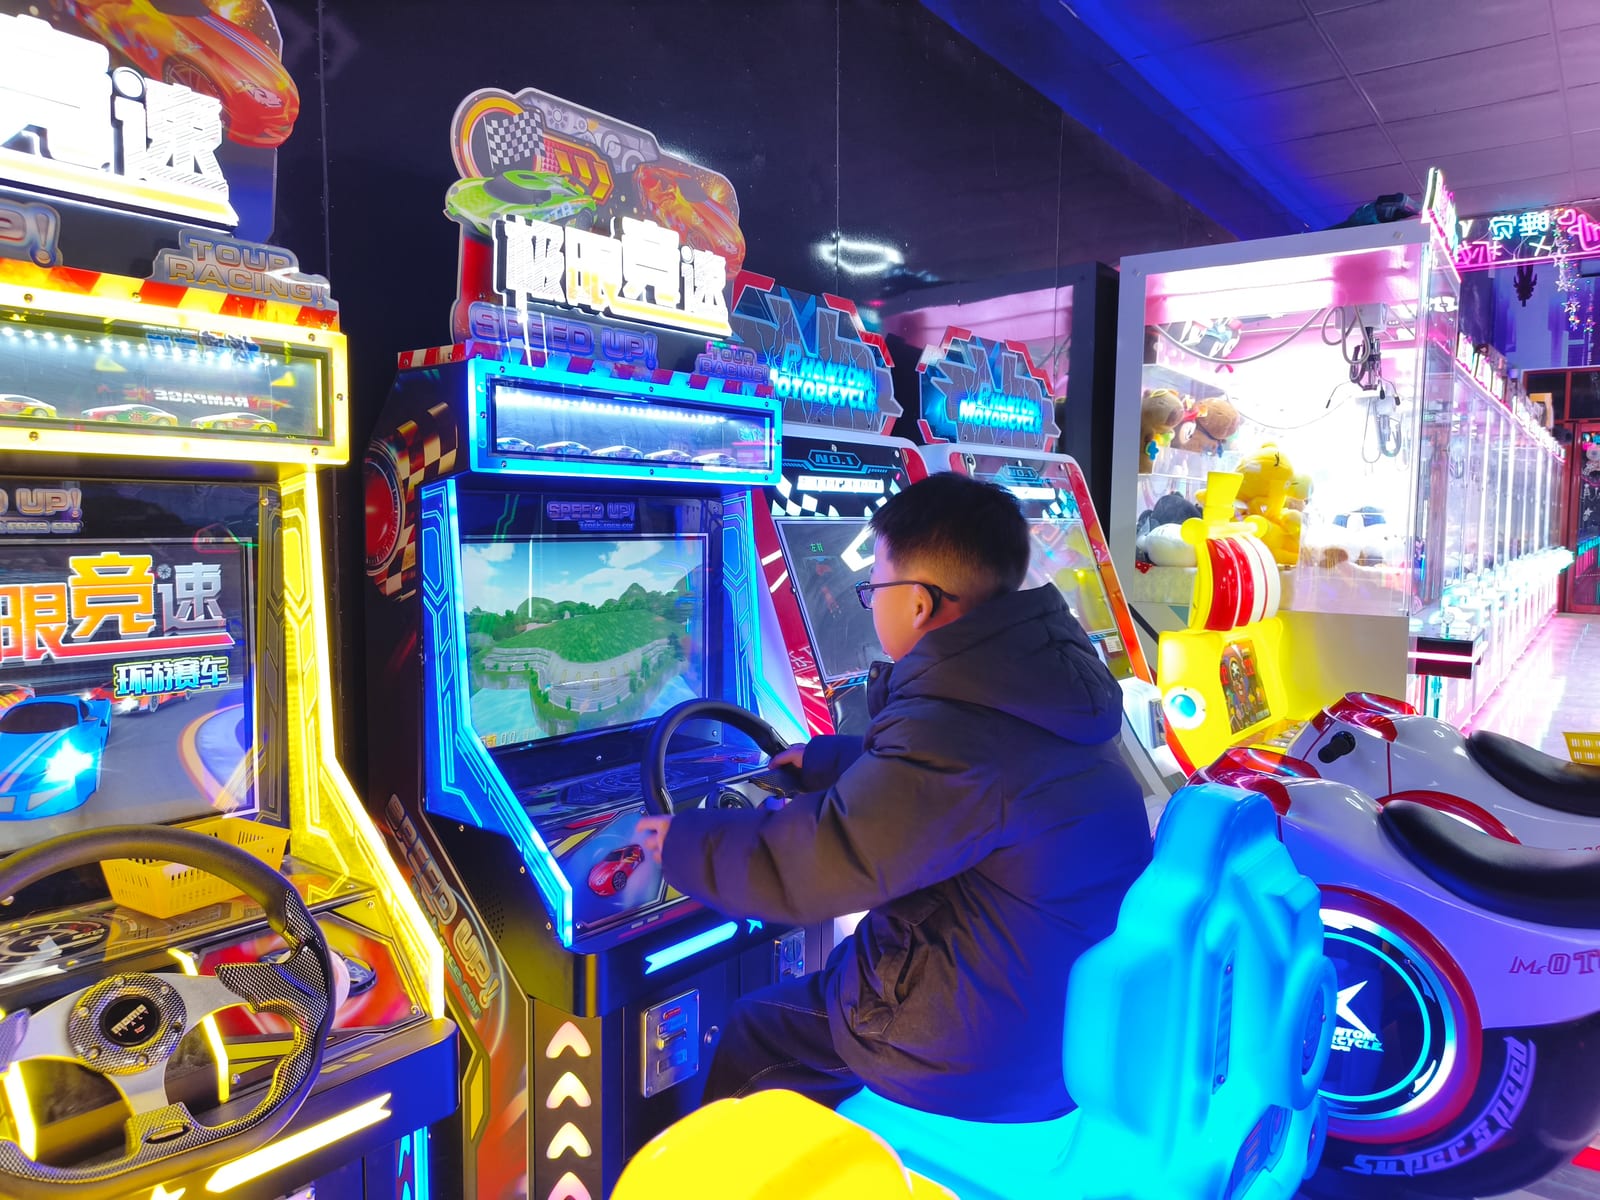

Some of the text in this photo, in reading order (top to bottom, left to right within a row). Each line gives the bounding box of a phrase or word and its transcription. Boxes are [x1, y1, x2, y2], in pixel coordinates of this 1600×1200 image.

[474, 310, 656, 370] SPEED UP!
[713, 349, 755, 366] TOUR
[702, 359, 769, 384] RACING!
[815, 453, 854, 465] NO.1
[548, 502, 635, 521] SPEED UP!
[115, 659, 228, 695] 环游赛车
[386, 794, 457, 926] SPEED
[1509, 949, 1600, 975] MOT
